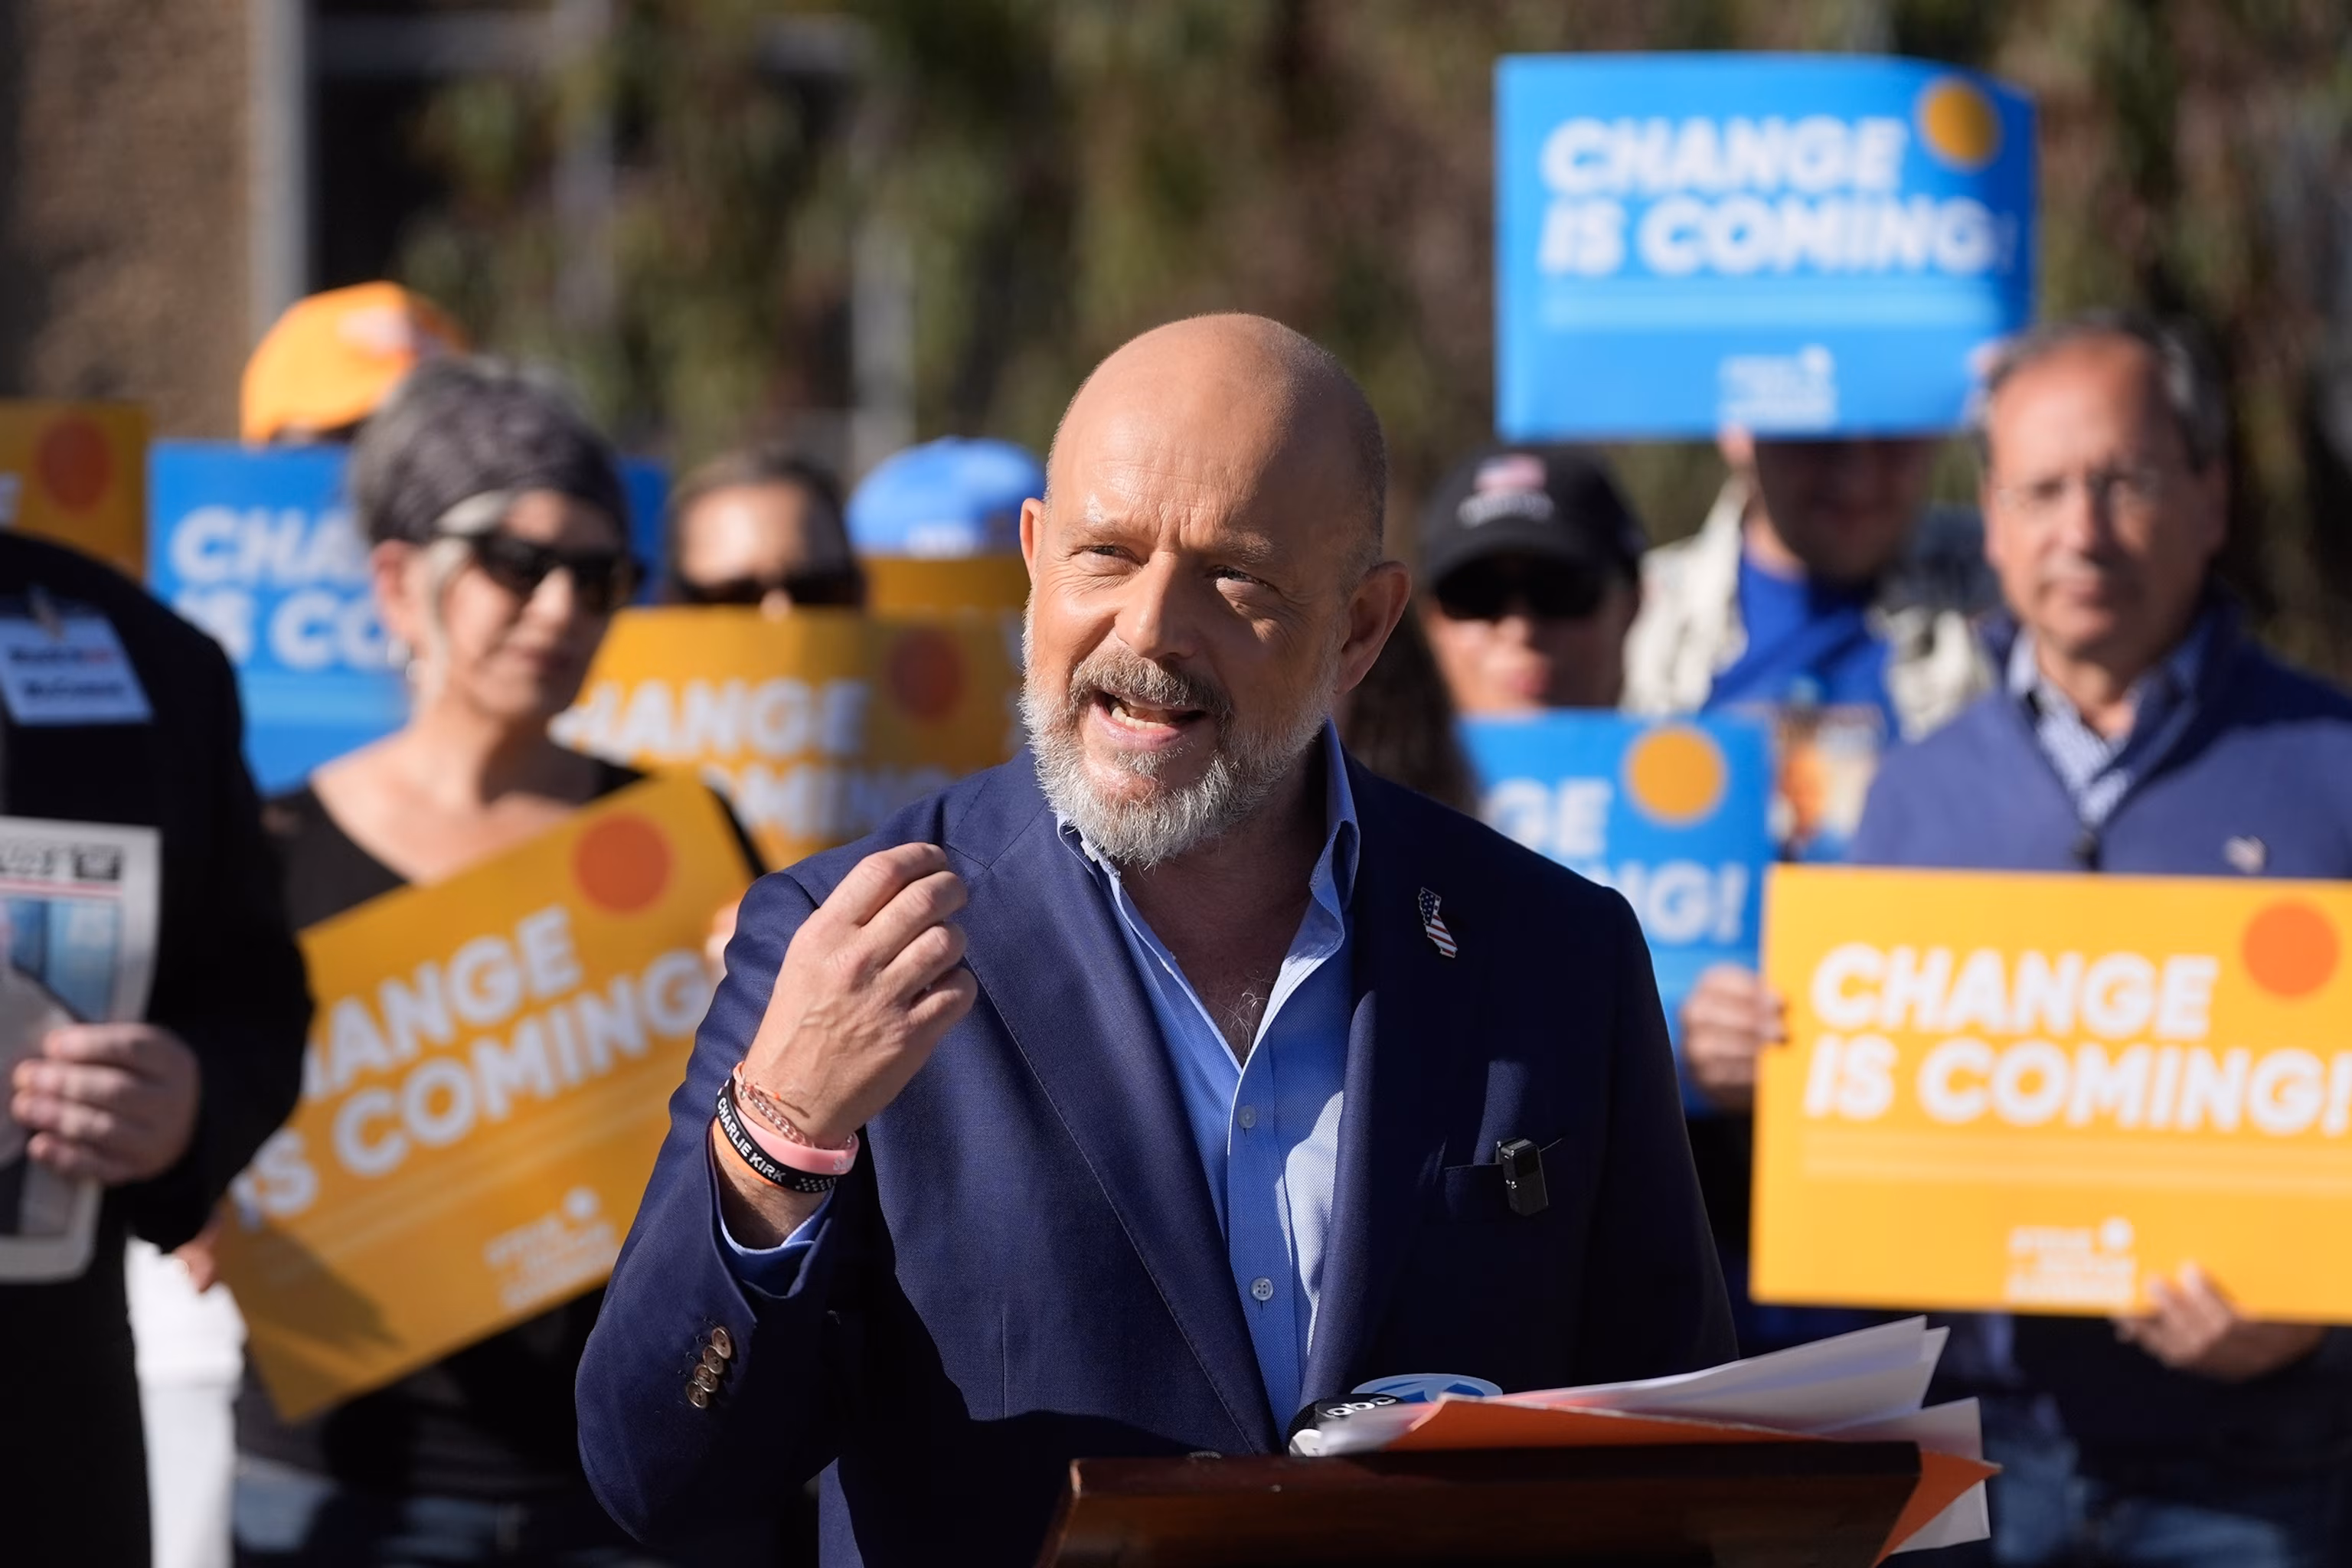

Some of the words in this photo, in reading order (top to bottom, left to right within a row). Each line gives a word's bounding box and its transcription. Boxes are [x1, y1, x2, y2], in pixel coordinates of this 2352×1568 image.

[1540, 116, 1908, 197] CHANGE
[1538, 196, 1626, 276] IS
[1637, 194, 2018, 276] COMING!
[169, 505, 363, 584] CHA
[547, 676, 868, 764] HANGE
[302, 904, 583, 1103] ANGE
[1811, 942, 2220, 1040] CHANGE
[332, 947, 712, 1177] COMING
[1803, 1033, 1897, 1122] IS
[1919, 1037, 2352, 1137] COMING!
[717, 1096, 753, 1158] CHARLIE
[749, 1152, 787, 1183] KIRK
[1325, 1396, 1397, 1417] abc
